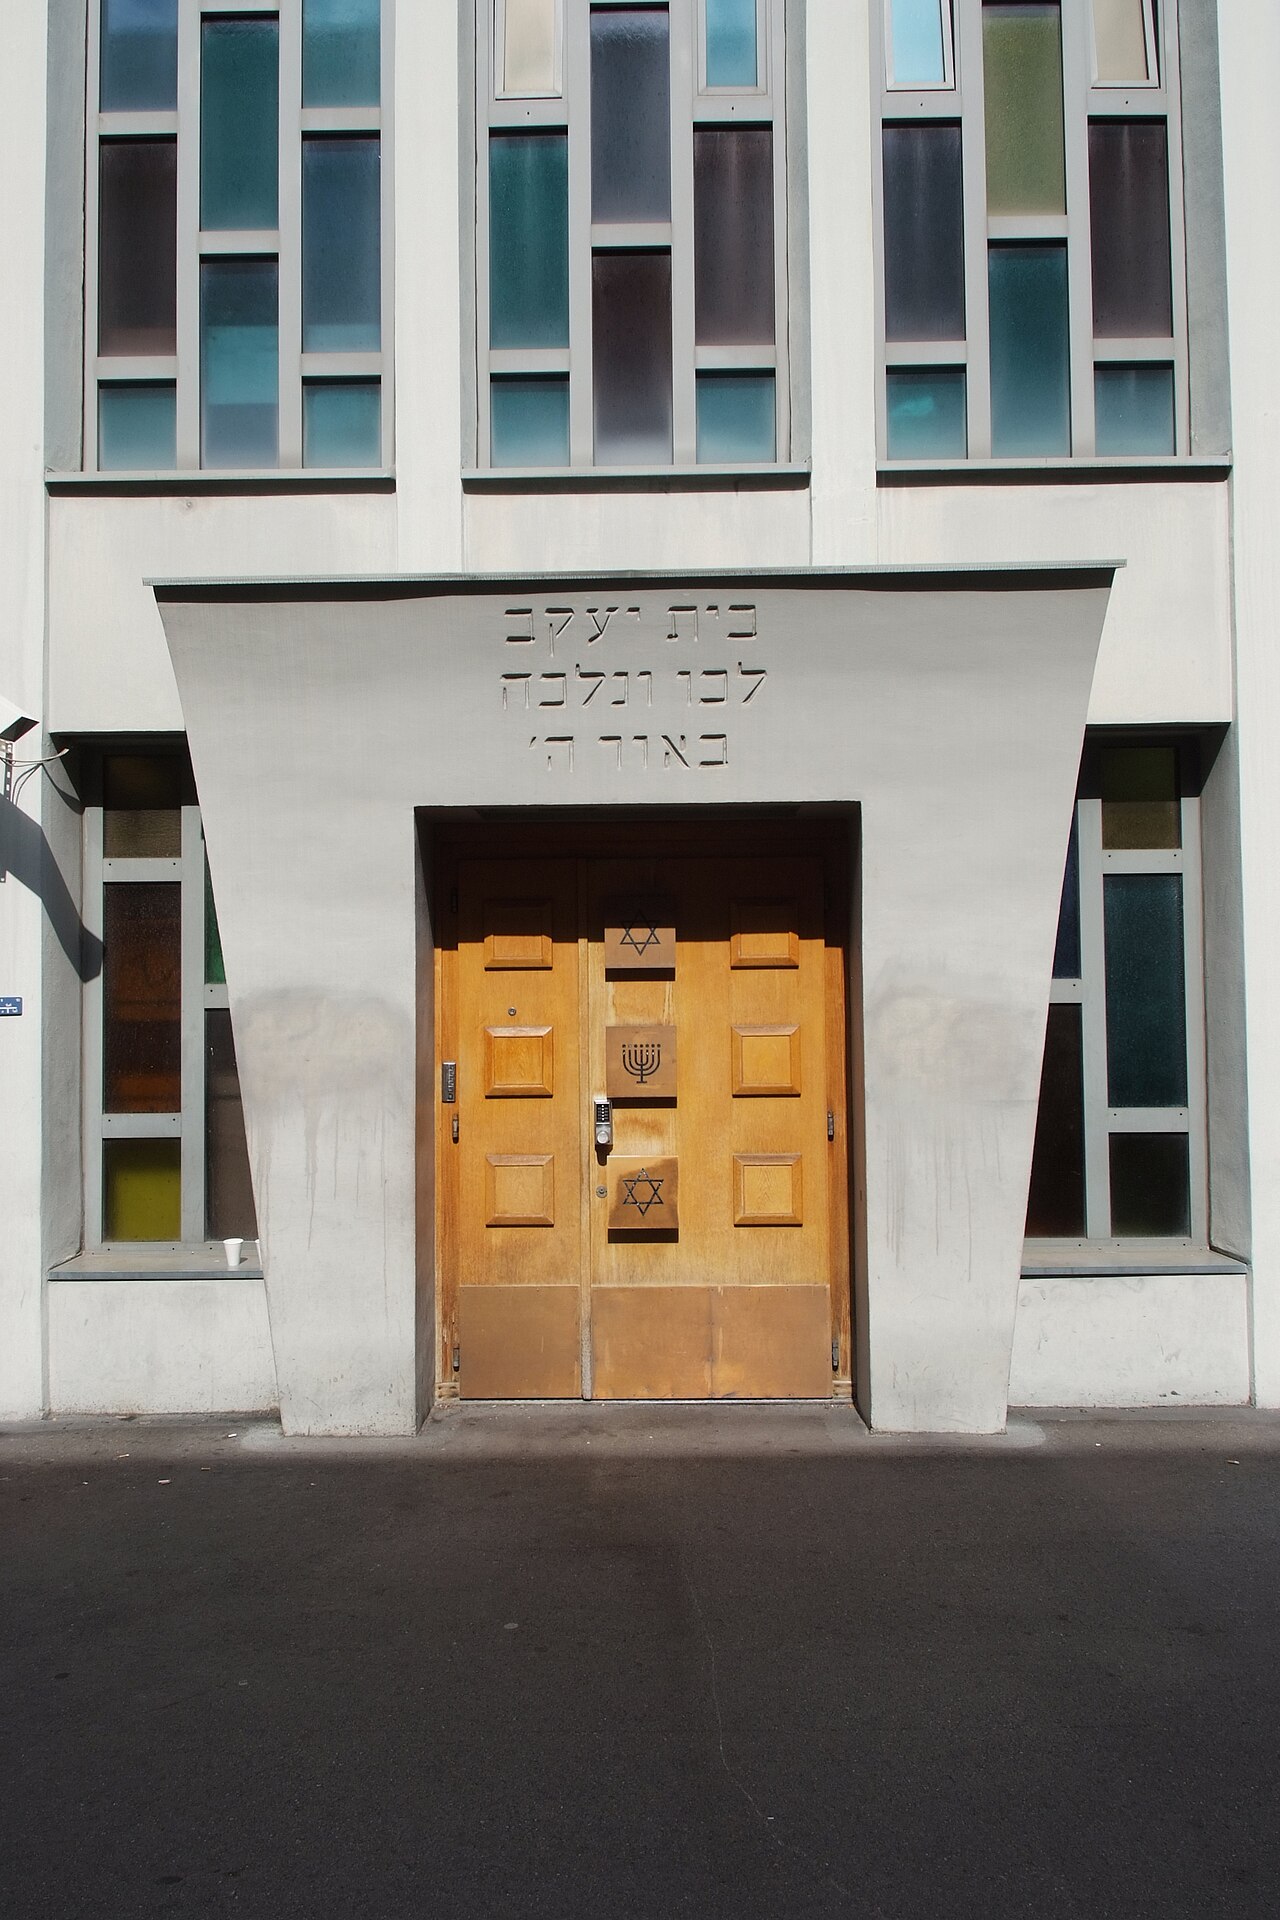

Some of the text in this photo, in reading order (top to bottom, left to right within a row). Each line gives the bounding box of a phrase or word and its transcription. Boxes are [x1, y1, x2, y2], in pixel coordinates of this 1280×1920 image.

[504, 604, 757, 658] בית יעקב
[500, 661, 768, 710] לכו ונלכה
[598, 733, 728, 768] באור
